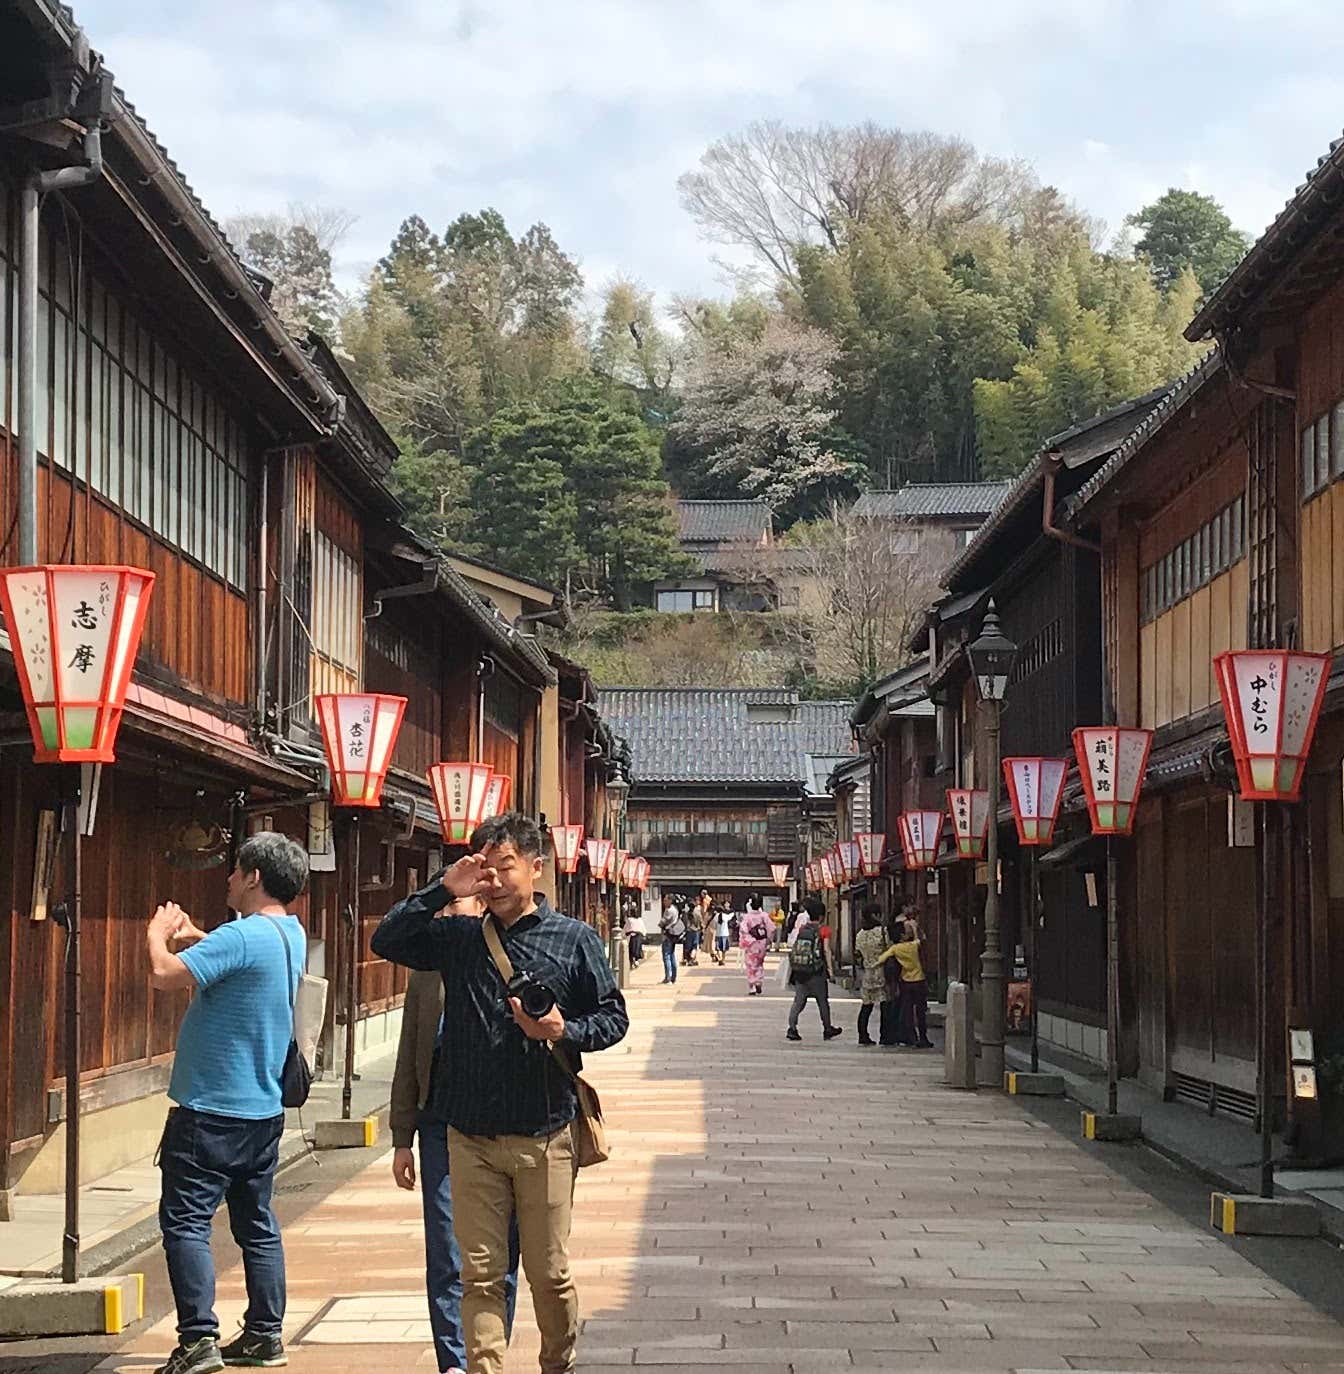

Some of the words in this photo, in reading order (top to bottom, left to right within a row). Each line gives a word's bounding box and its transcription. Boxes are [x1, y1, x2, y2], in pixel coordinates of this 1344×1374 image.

[99, 581, 110, 617] ひがし
[67, 600, 97, 673] 志摩
[1250, 674, 1268, 735] 中むら
[349, 722, 364, 757] 杏花
